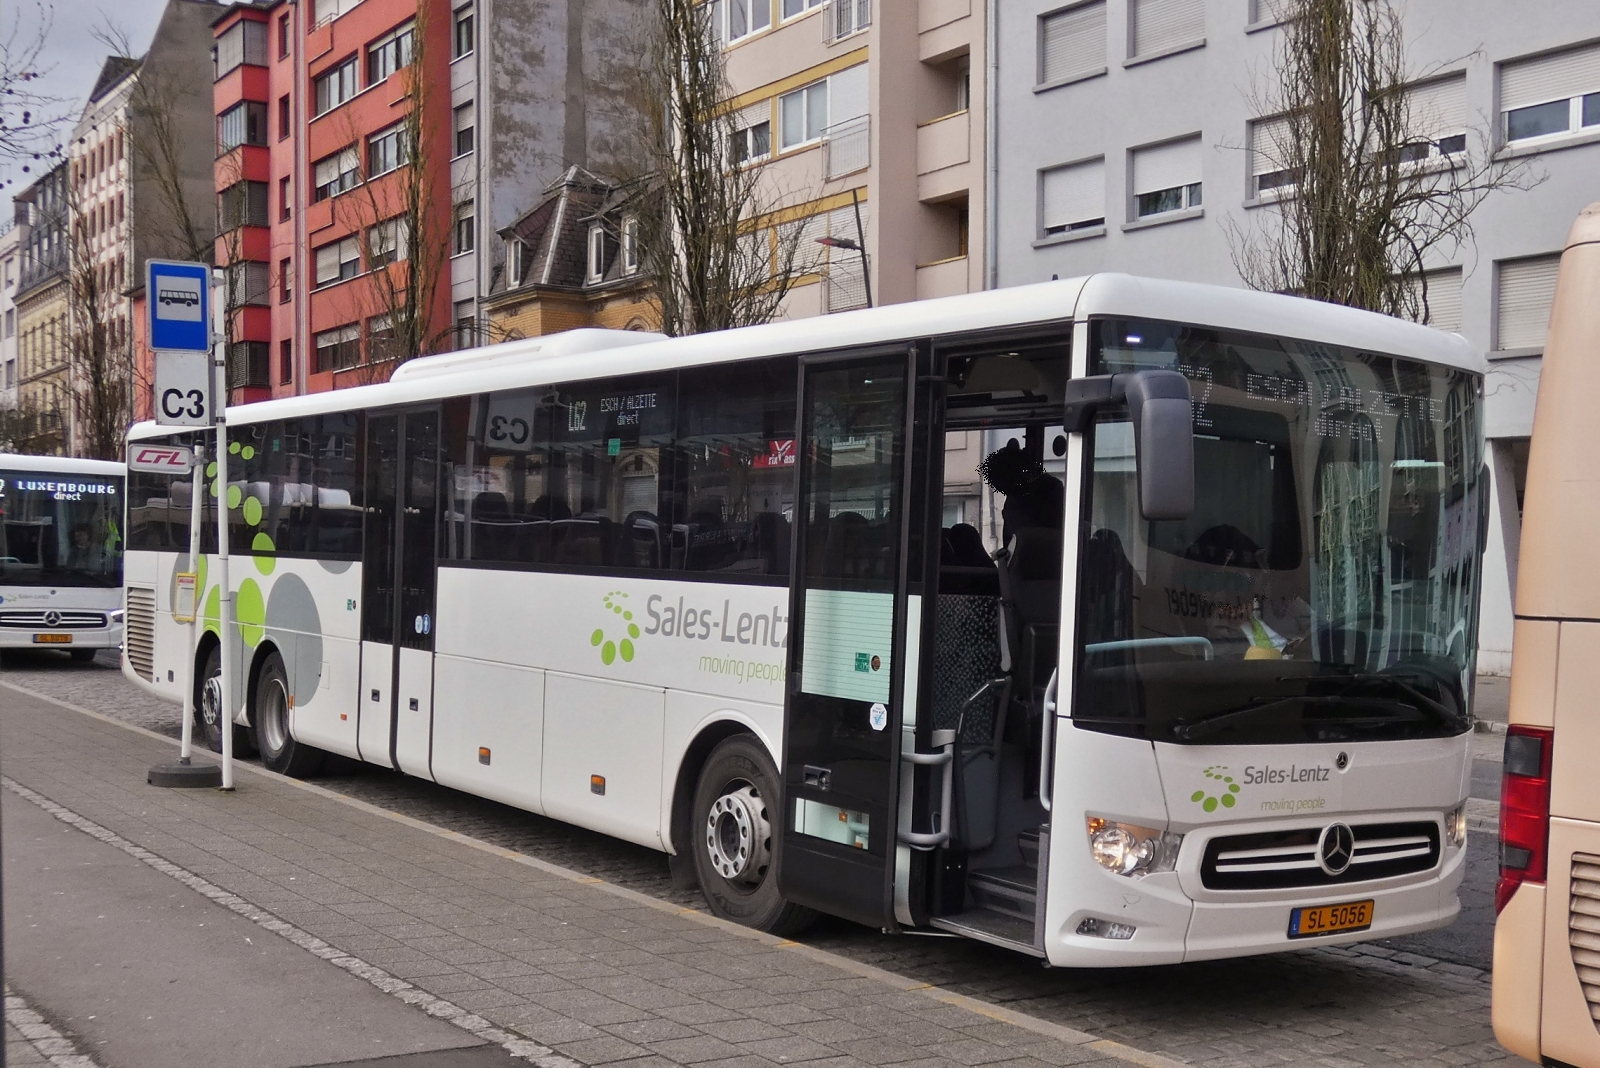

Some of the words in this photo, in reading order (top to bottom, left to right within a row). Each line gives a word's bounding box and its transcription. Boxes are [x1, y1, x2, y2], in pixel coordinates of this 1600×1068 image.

[161, 388, 205, 419] C3
[600, 396, 619, 412] ESCH
[135, 449, 187, 466] CFL
[17, 480, 116, 495] LUXEMBOURG
[53, 491, 82, 501] direct
[698, 653, 745, 685] moving
[1243, 764, 1331, 785] Sales-Lentz
[1260, 798, 1295, 814] moving
[1296, 797, 1326, 812] people
[1308, 910, 1325, 930] SL
[1329, 904, 1367, 927] 5056
